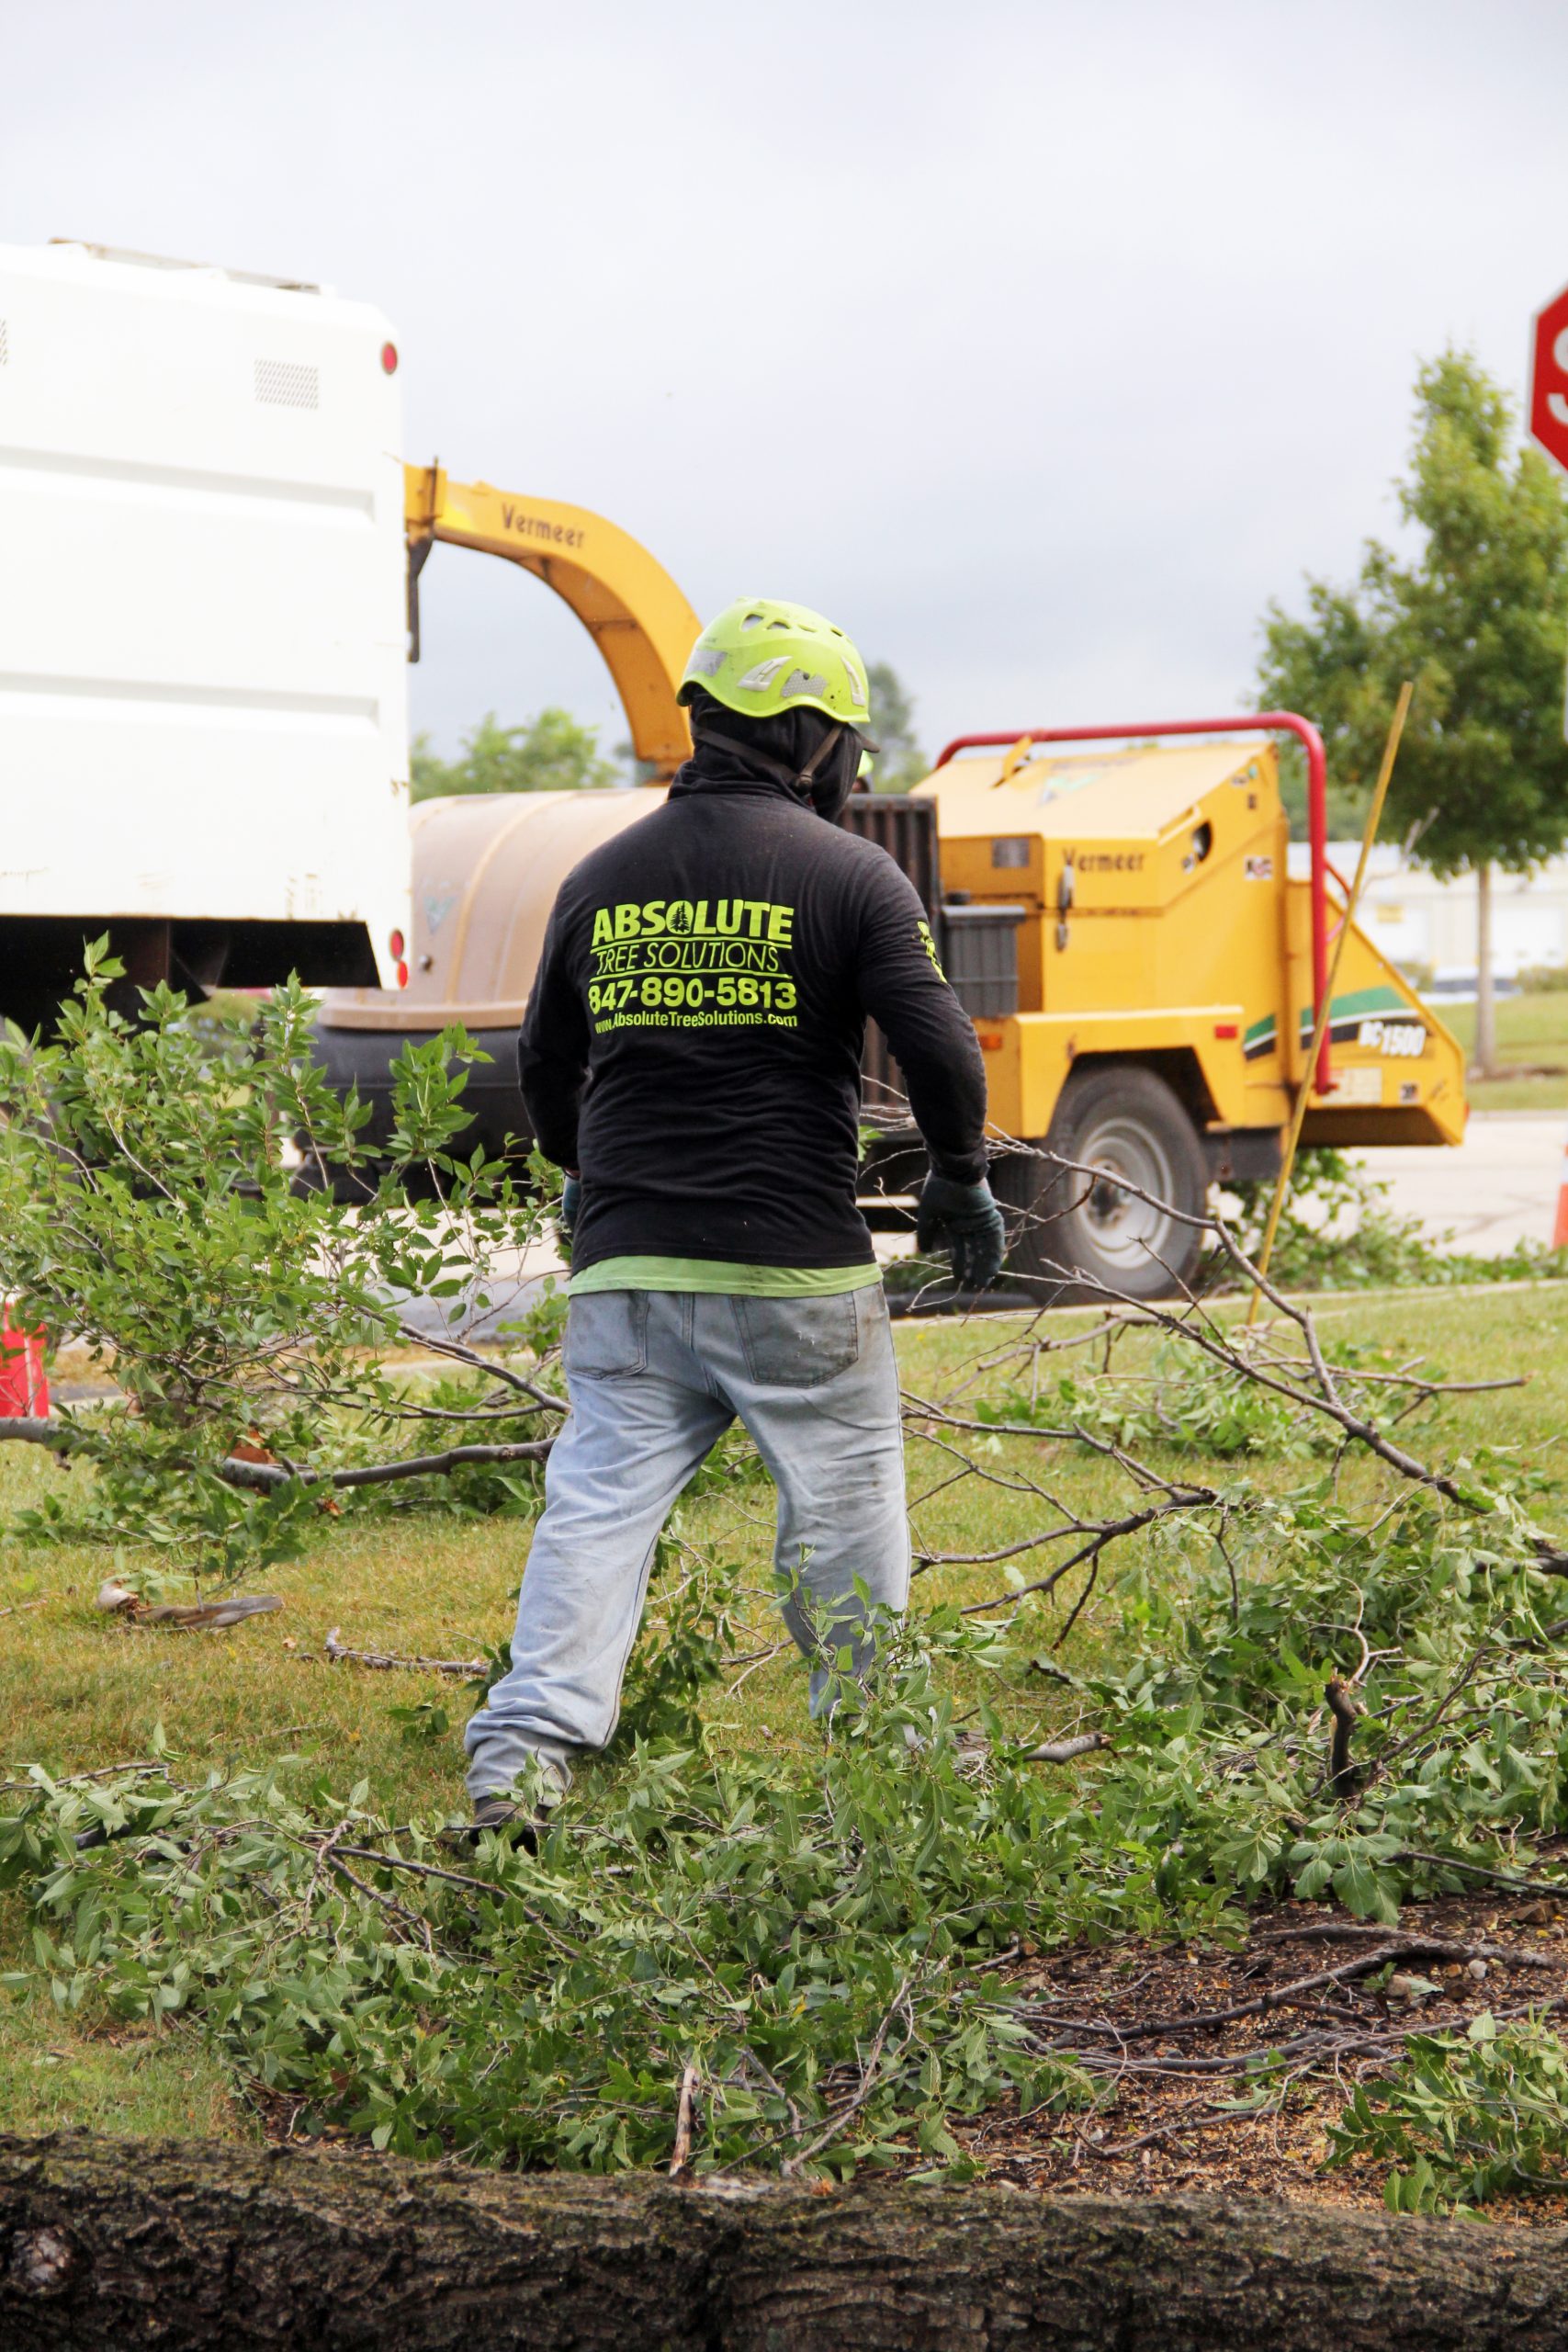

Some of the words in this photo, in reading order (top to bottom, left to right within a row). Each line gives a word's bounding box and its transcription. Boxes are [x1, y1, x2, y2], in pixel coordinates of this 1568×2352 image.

[502, 502, 584, 548] Vermeer
[1062, 847, 1145, 873] Vermeer
[592, 899, 795, 947] ABSOLUTE
[596, 944, 640, 976] TREE
[643, 942, 779, 972] SOLUTIONS
[588, 976, 797, 1015] 847-890-5813
[594, 1010, 798, 1035] www.AbsoluteTreeSolutions.com
